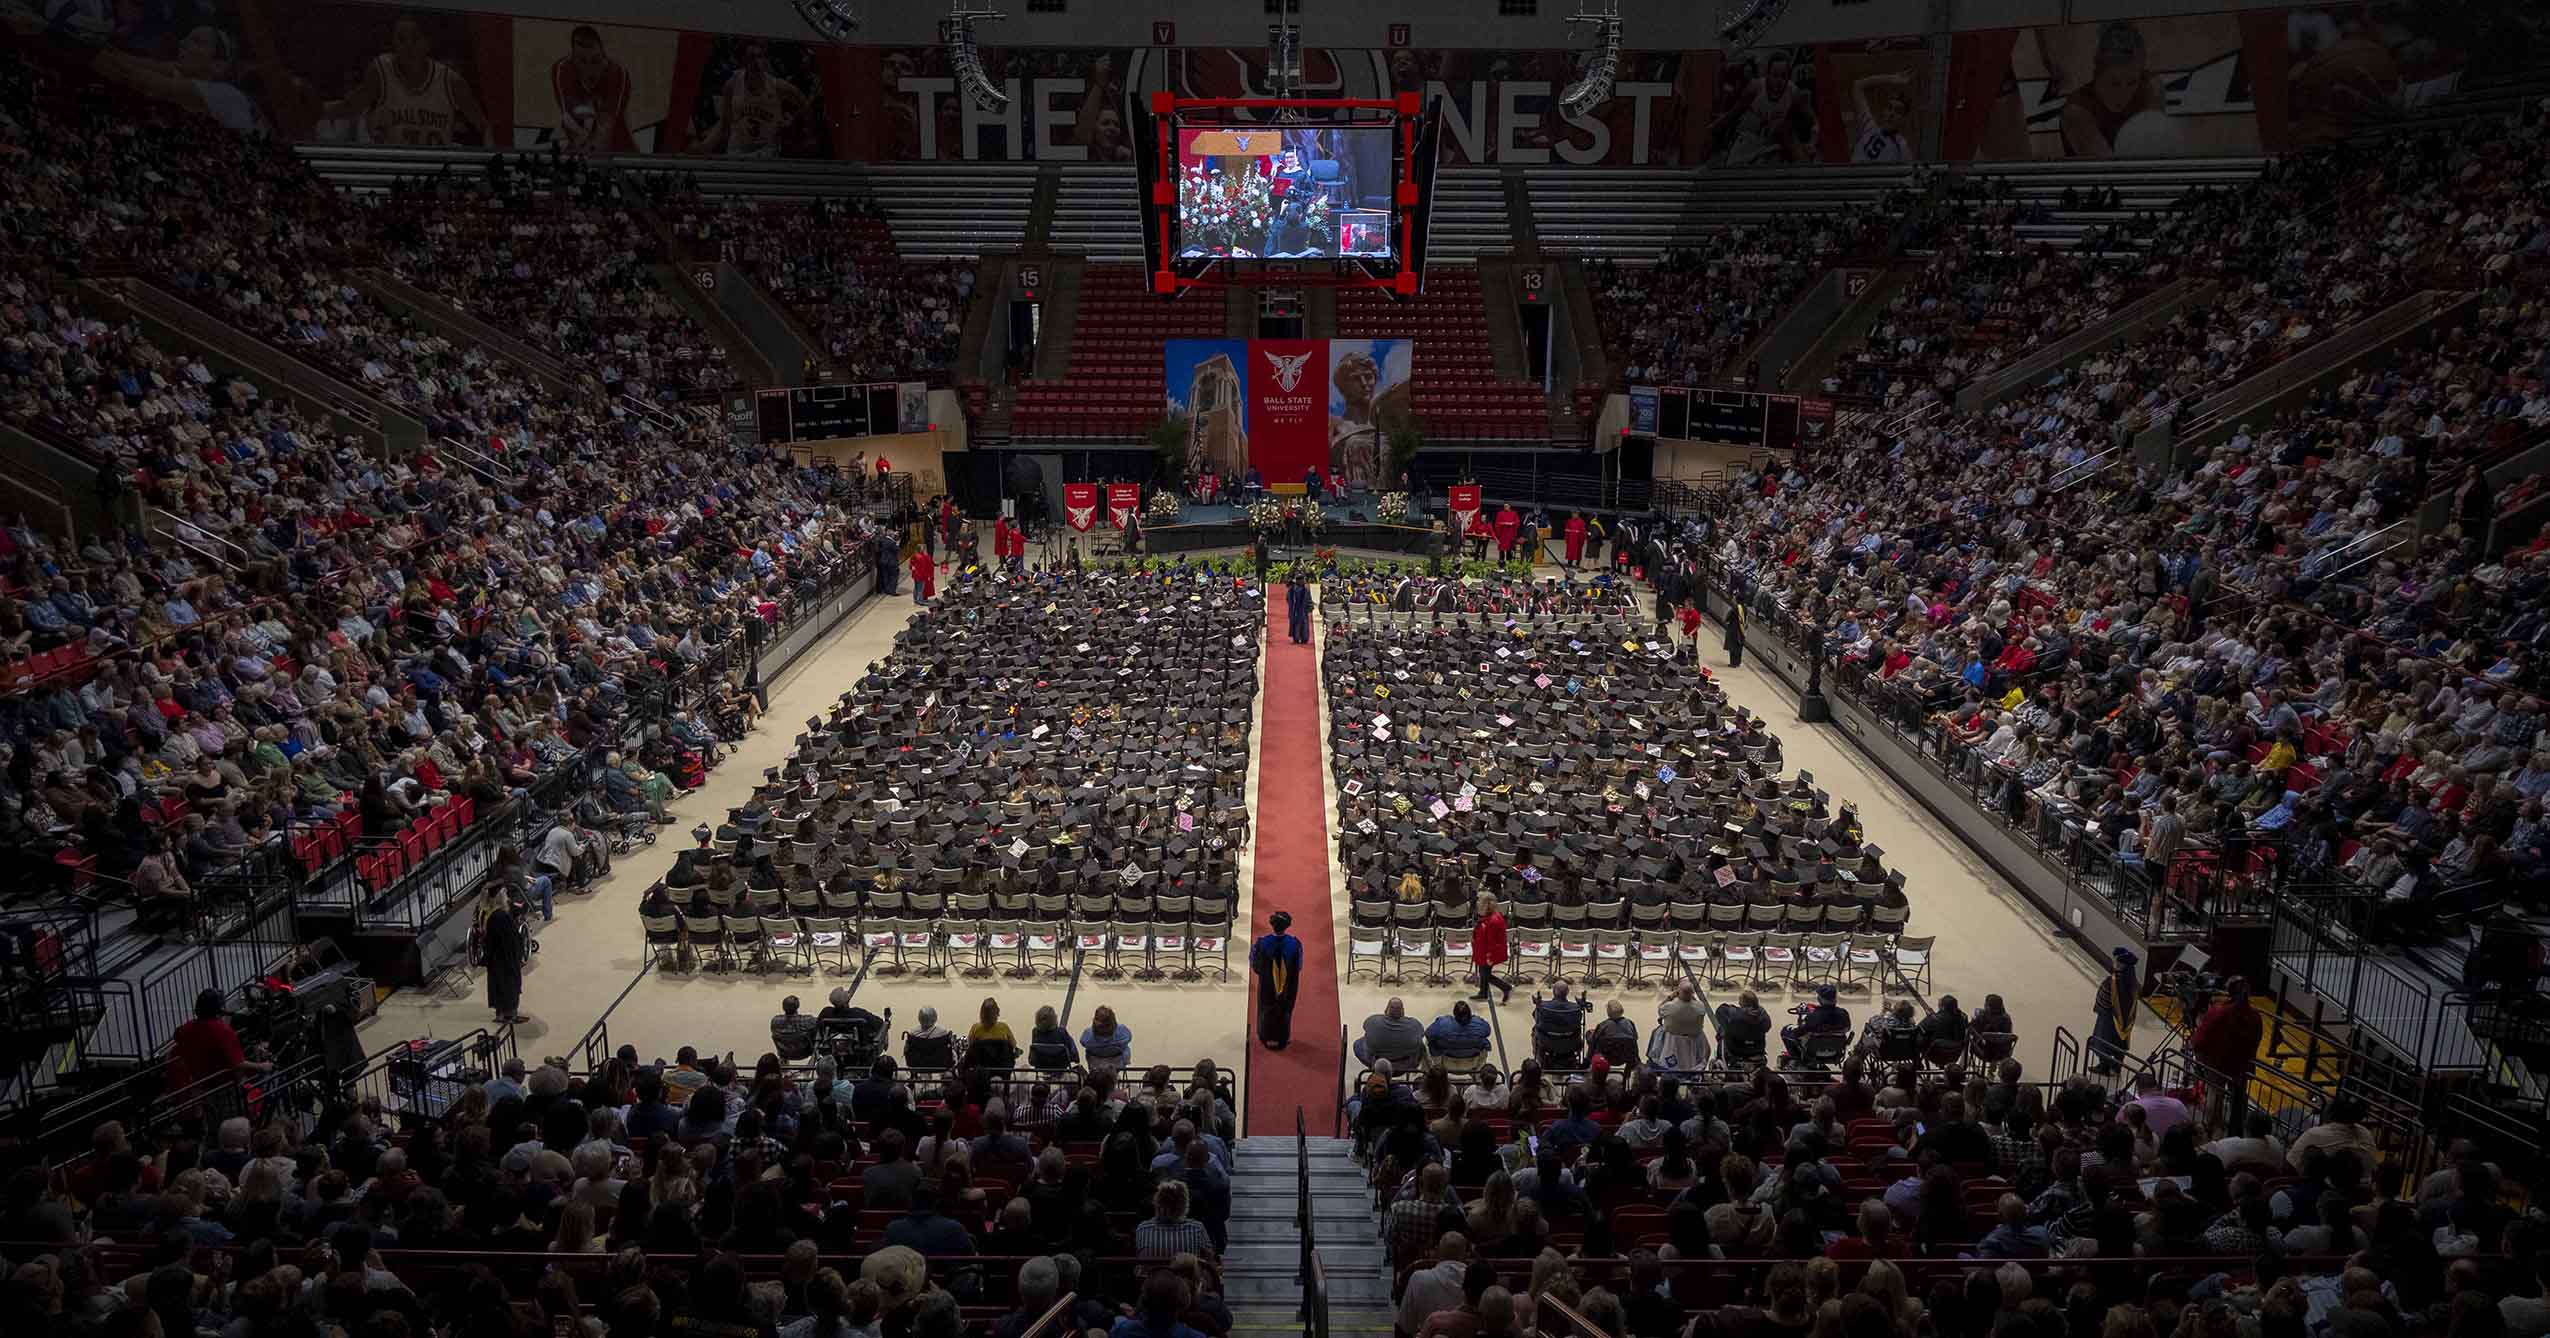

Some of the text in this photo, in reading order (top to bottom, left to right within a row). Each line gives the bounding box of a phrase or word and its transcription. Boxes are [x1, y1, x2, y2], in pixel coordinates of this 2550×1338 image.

[897, 77, 1672, 165] THE NEST
[1020, 271, 1039, 287] 15
[1522, 273, 1542, 289] 13
